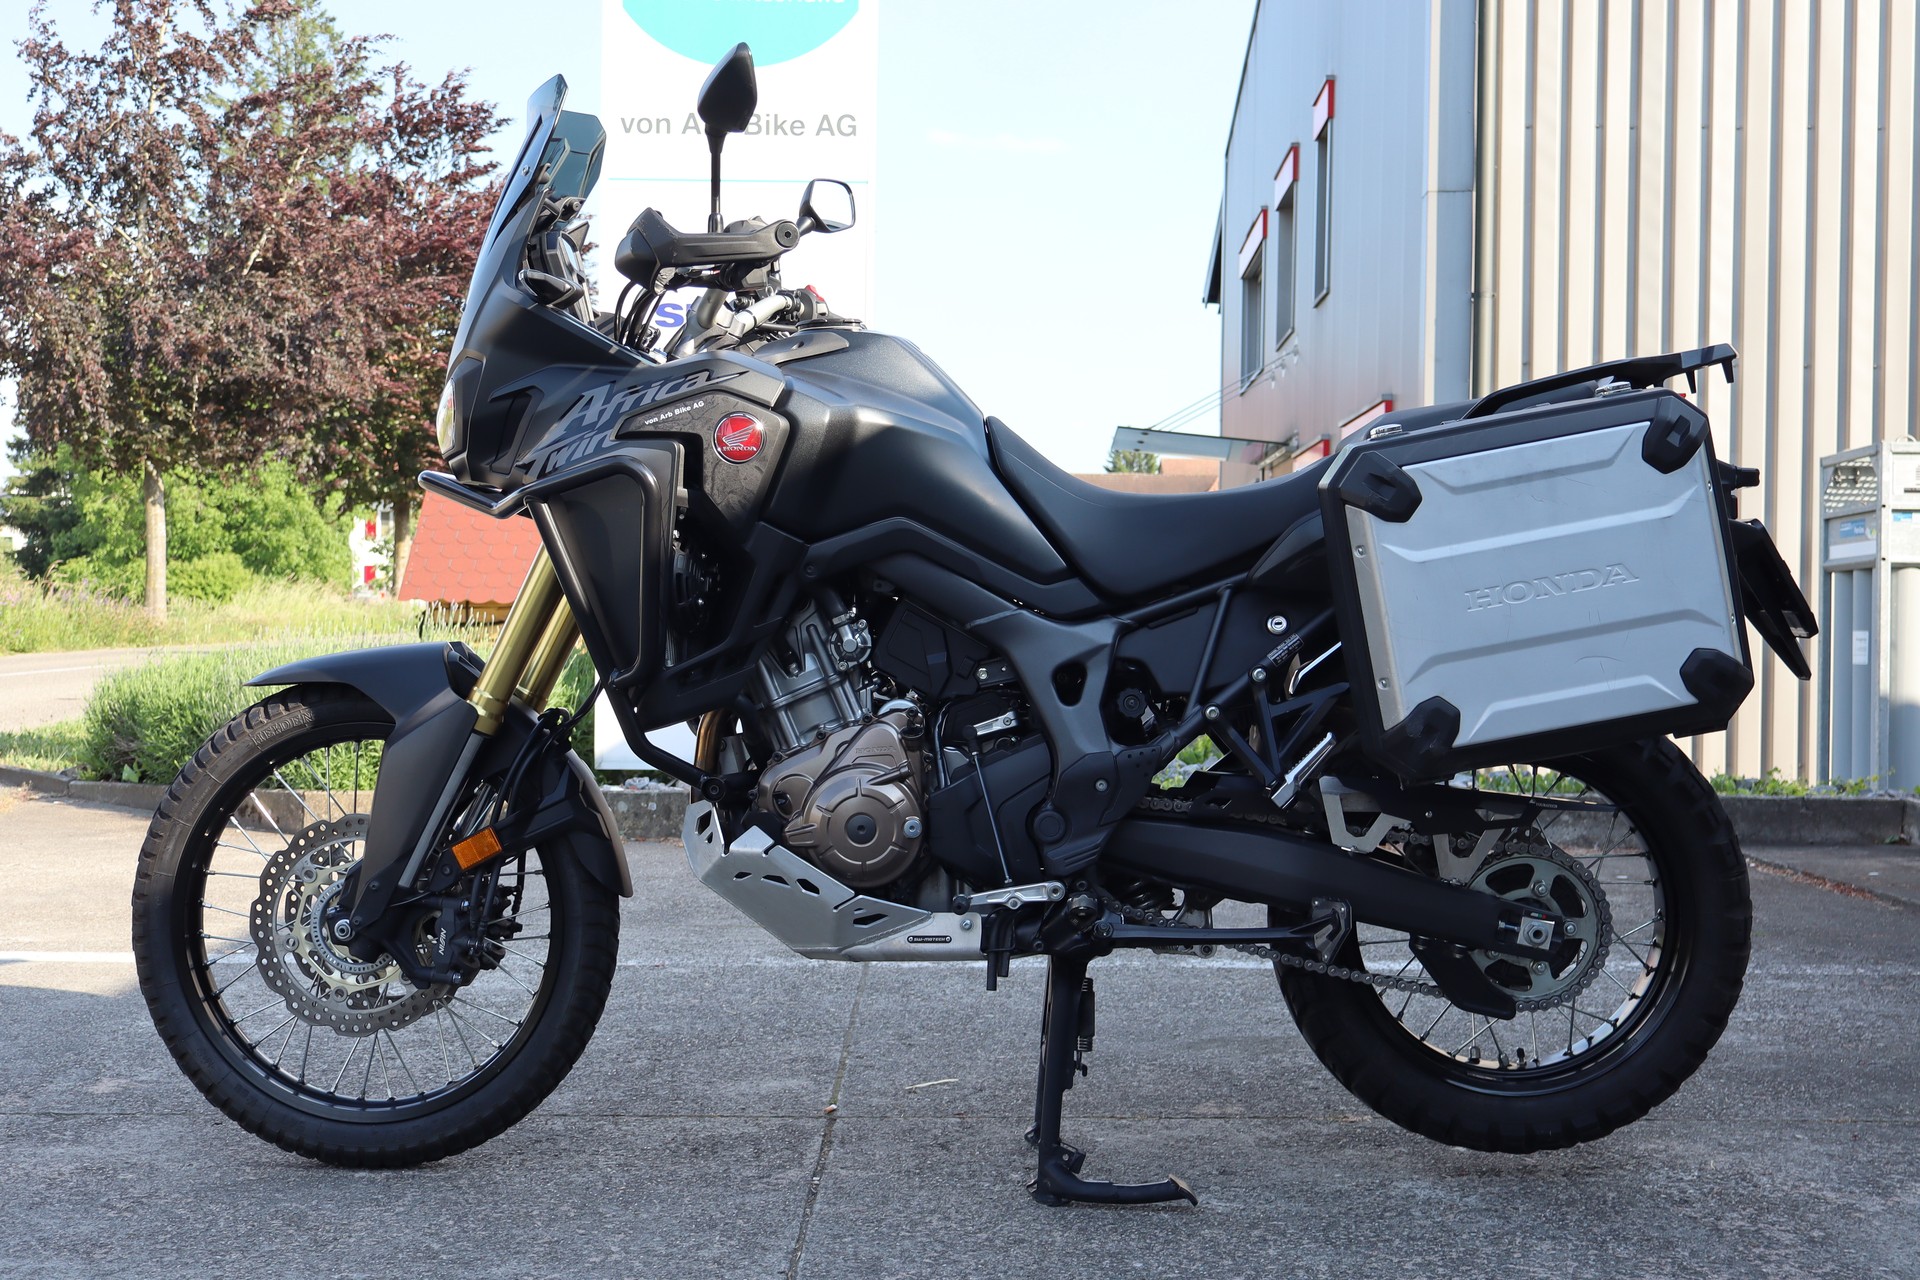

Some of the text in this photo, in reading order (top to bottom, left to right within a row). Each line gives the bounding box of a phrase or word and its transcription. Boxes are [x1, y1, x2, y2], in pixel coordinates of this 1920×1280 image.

[620, 116, 671, 135] von
[743, 113, 806, 137] Bike
[815, 114, 858, 137] AG
[550, 370, 749, 437] Africa
[644, 400, 705, 426] von Arb Bike AG
[516, 428, 619, 484] Twin
[1464, 562, 1640, 612] HONDA
